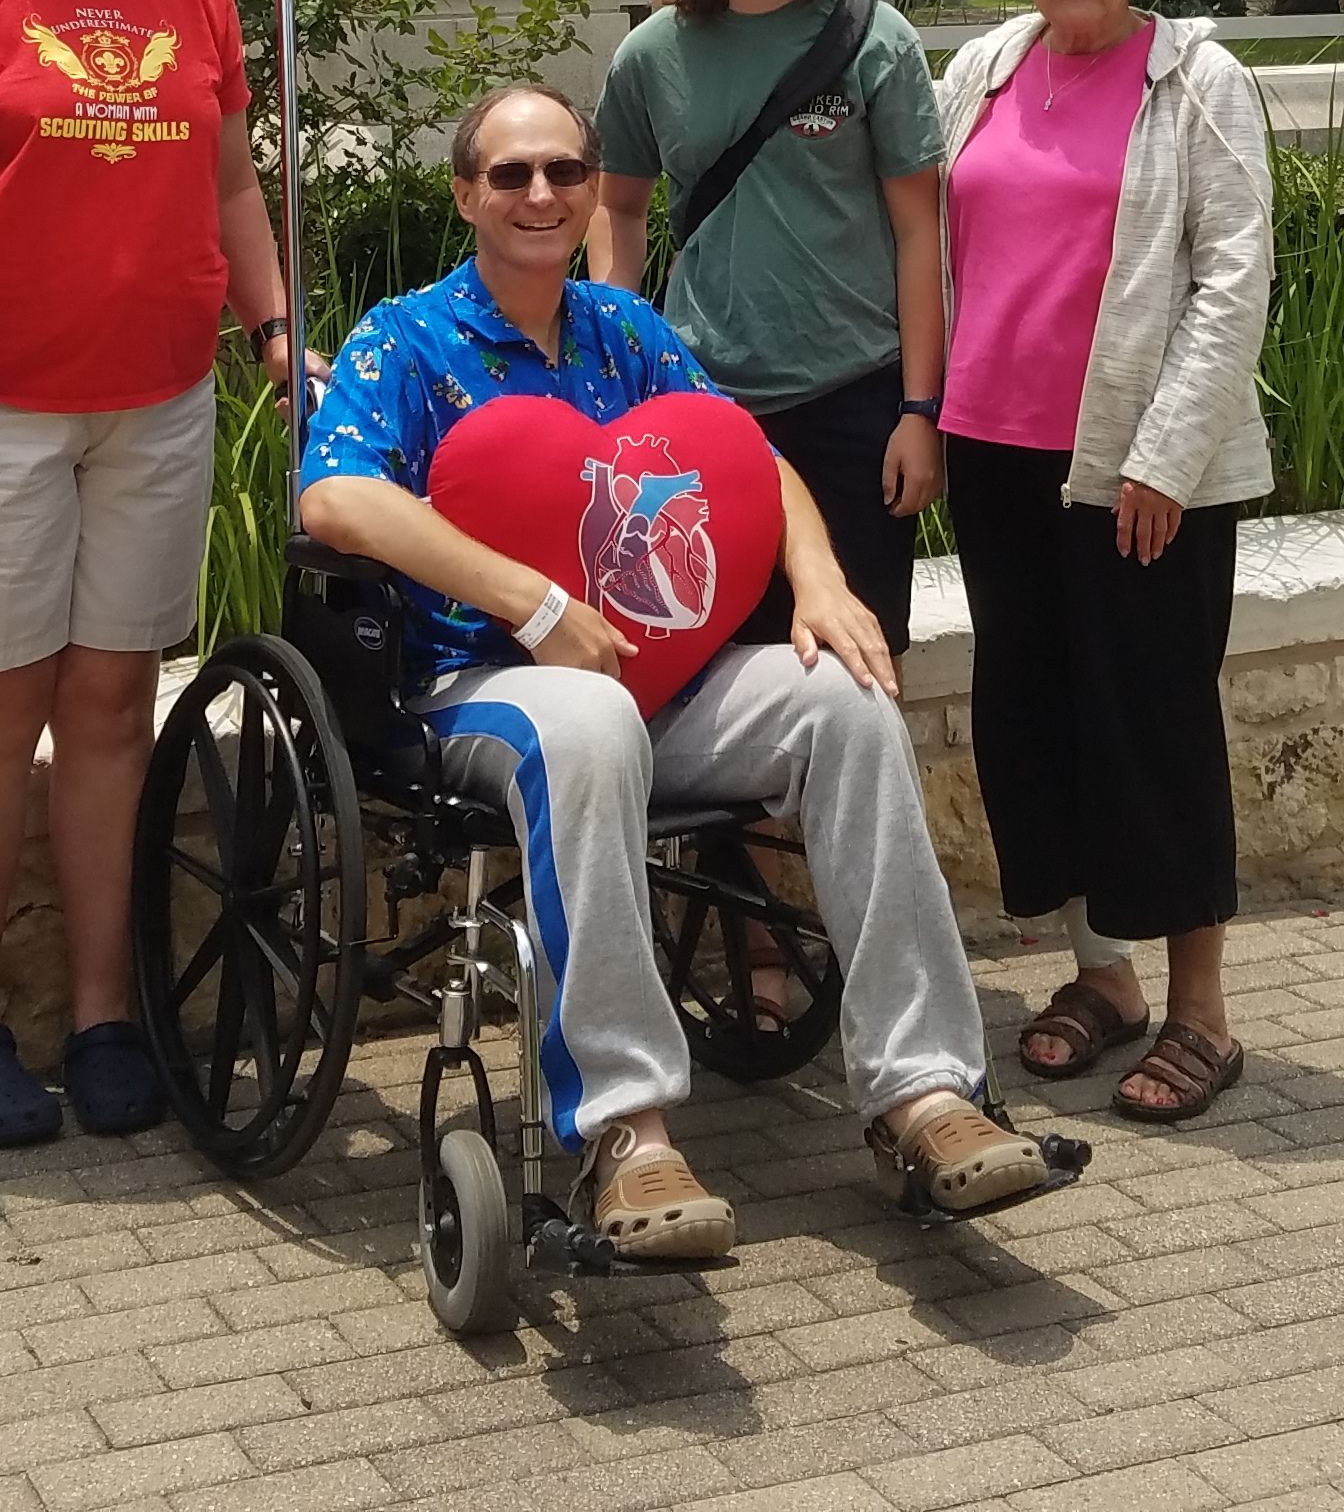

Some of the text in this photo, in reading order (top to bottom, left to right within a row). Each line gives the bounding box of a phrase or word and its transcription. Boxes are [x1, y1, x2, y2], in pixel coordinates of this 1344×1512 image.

[76, 7, 124, 20] NEVER
[50, 19, 155, 39] UNDERESTIMATE
[72, 83, 158, 103] THE POWER OF
[75, 102, 158, 120] A WOMAN WITH
[829, 106, 849, 117] RIM
[40, 117, 190, 142] SCOUTING SKILLS
